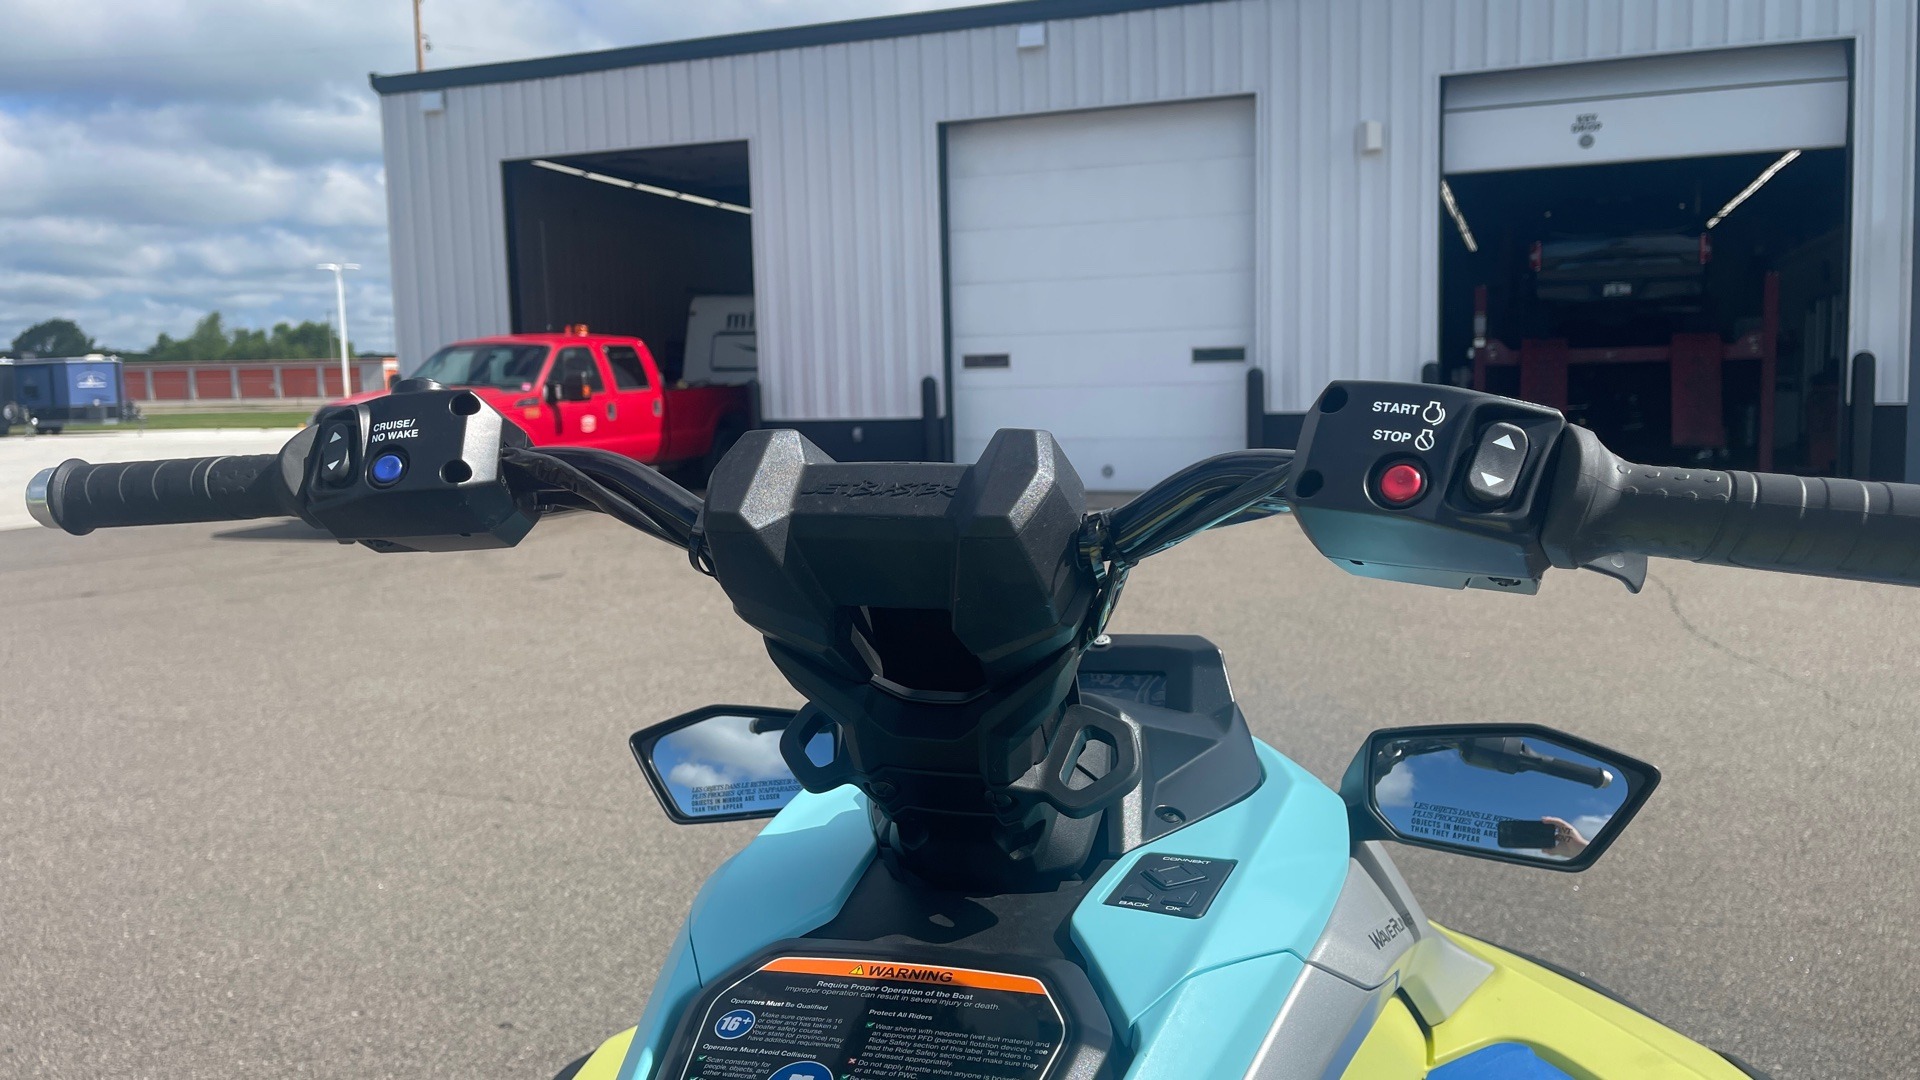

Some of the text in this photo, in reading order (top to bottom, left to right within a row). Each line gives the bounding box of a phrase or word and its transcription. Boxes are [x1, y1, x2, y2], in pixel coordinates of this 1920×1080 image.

[1372, 401, 1420, 415] START
[373, 418, 416, 432] CRUISE/
[371, 428, 419, 443] NO WAKE
[1372, 429, 1411, 443] STOP
[707, 790, 734, 798] PROCHES
[759, 793, 780, 801] CLOSER
[1412, 809, 1433, 819] PLUS
[1434, 812, 1472, 825] PROCHES
[1413, 801, 1429, 810] LES
[1429, 803, 1458, 815] OBJETS
[1458, 808, 1480, 819] DANS
[1481, 811, 1492, 820] LE
[1411, 817, 1497, 838] OBJECTS IN MIRROR ARE
[1411, 825, 1480, 843] THAN THEY APPEAR
[1162, 856, 1211, 865] CONNEXT
[1118, 900, 1150, 908] BACK
[868, 966, 954, 983] WARNING
[816, 981, 974, 1000] Require Proper Operation of the Boat
[730, 998, 765, 1006] Operators
[796, 1002, 828, 1011] Qualified
[785, 986, 819, 995] Improper
[821, 988, 859, 997] operation
[876, 992, 900, 1000] result
[910, 996, 937, 1004] severe
[939, 998, 961, 1008] injury
[975, 1002, 1000, 1011] death.
[796, 1015, 825, 1023] operator
[868, 1009, 896, 1017] Protect
[908, 1013, 933, 1021] Riders
[720, 1016, 752, 1031] 16+
[777, 1025, 798, 1033] safety
[795, 1033, 828, 1042] province)
[875, 1023, 893, 1031] Wear
[894, 1025, 917, 1033] shorts
[918, 1027, 933, 1035] with
[934, 1030, 968, 1039] neoprene
[1002, 1037, 1034, 1047] material)
[882, 1031, 917, 1040] approved
[917, 1034, 934, 1042] PFD
[934, 1036, 968, 1046] (personal
[969, 1041, 999, 1049] flotation
[1000, 1044, 1027, 1053] device)
[702, 1043, 817, 1059] Operators Must Avoid Collisions
[796, 1040, 841, 1049] requirements.
[889, 1038, 911, 1048] Safety
[913, 1042, 940, 1050] section
[965, 1047, 982, 1055] label.
[1000, 1051, 1021, 1060] riders
[724, 1059, 759, 1068] constantly
[874, 1052, 904, 1061] dressed
[904, 1056, 953, 1067] appropriately.
[882, 1045, 893, 1053] the
[895, 1046, 915, 1055] Rider
[915, 1049, 938, 1058] Safety
[939, 1052, 966, 1061] section
[1022, 1062, 1039, 1071] they
[703, 1063, 727, 1071] people,
[857, 1059, 868, 1067] Do
[883, 1062, 904, 1070] apply
[905, 1064, 931, 1073] throttle
[932, 1068, 952, 1076] when
[954, 1071, 982, 1080] anyone
[722, 1071, 757, 1080] watercraft.
[888, 1069, 897, 1077] of
[897, 1071, 918, 1080] PWC.
